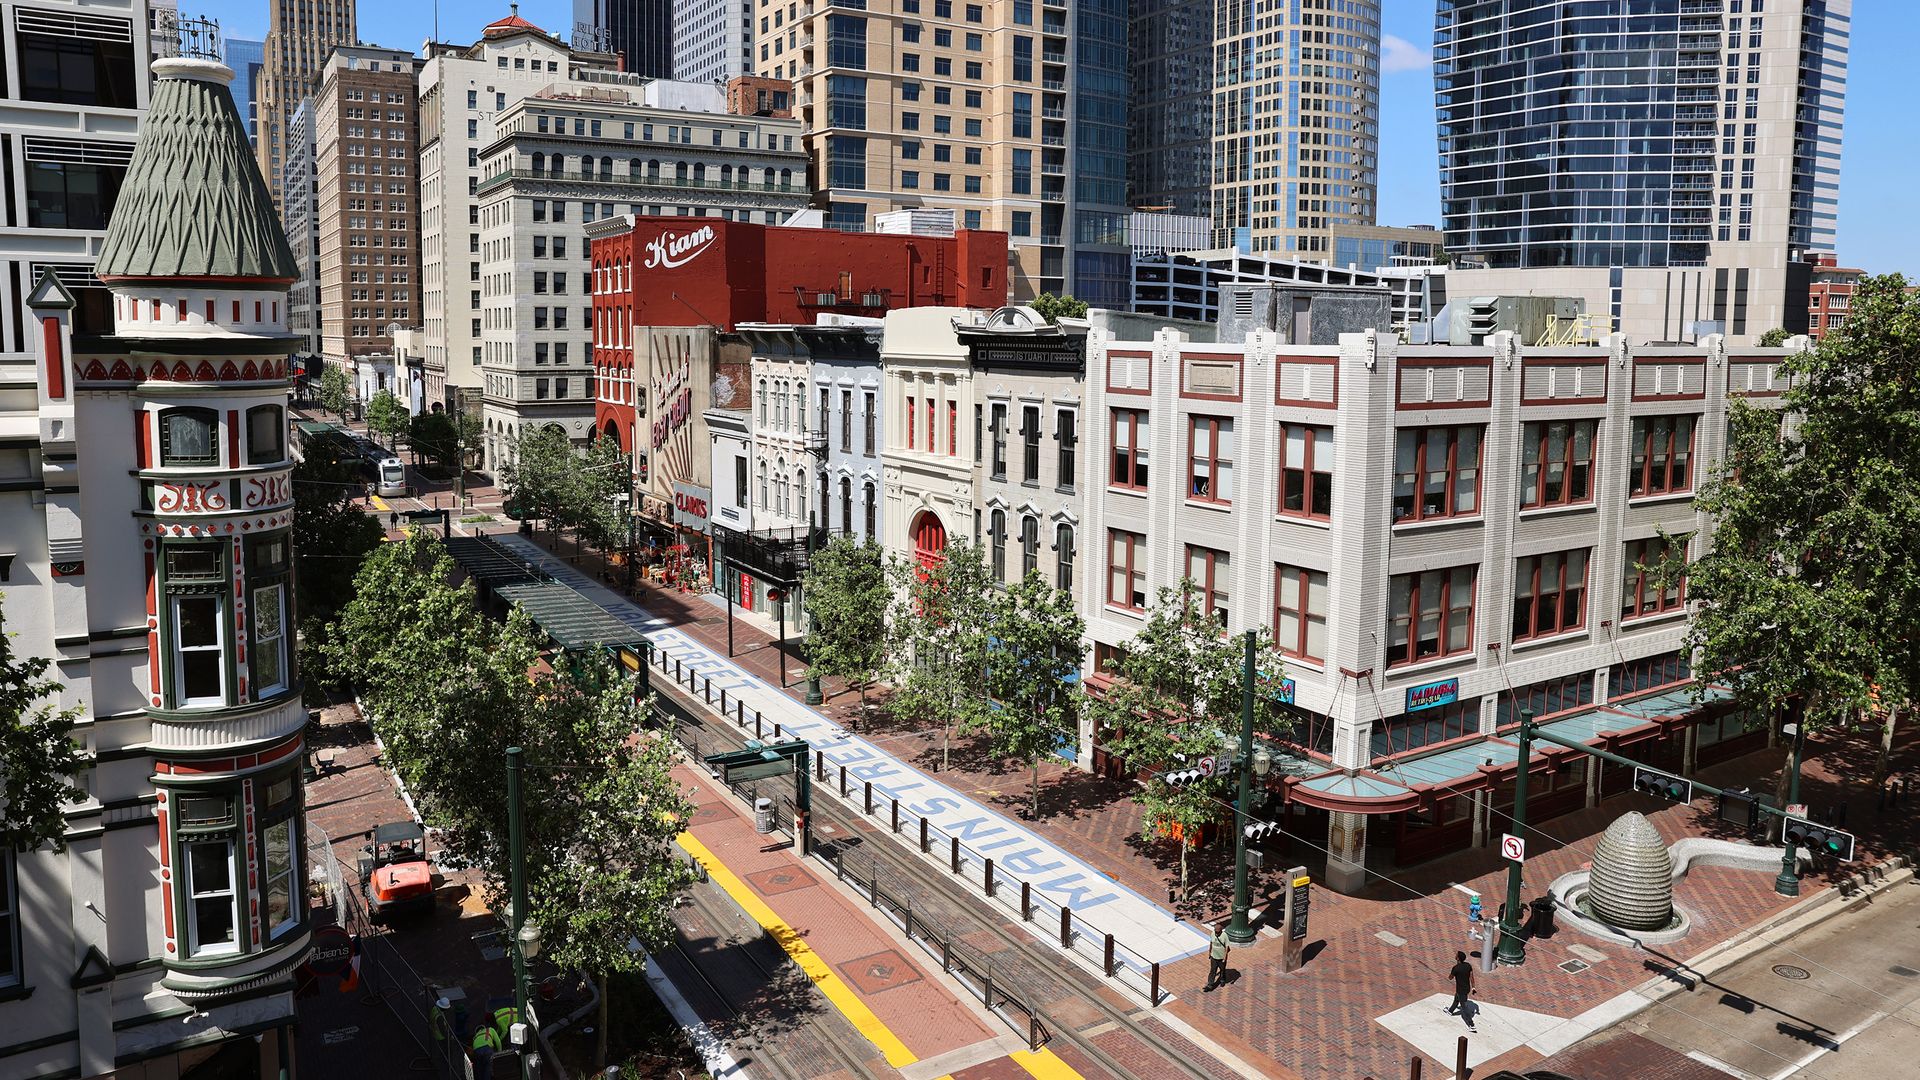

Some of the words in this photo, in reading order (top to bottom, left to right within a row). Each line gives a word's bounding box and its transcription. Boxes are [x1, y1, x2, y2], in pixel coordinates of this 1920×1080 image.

[573, 36, 617, 55] HOTEL
[576, 22, 611, 38] RICE
[645, 226, 717, 268] Kiam
[1018, 352, 1047, 361] STUART
[652, 414, 668, 448] EASY
[669, 388, 690, 430] CREDIT
[675, 491, 708, 520] CLARKS
[654, 633, 762, 690] STREET
[780, 722, 962, 816] STREET
[1220, 753, 1231, 761] ONE
[944, 817, 1121, 912] MAIN
